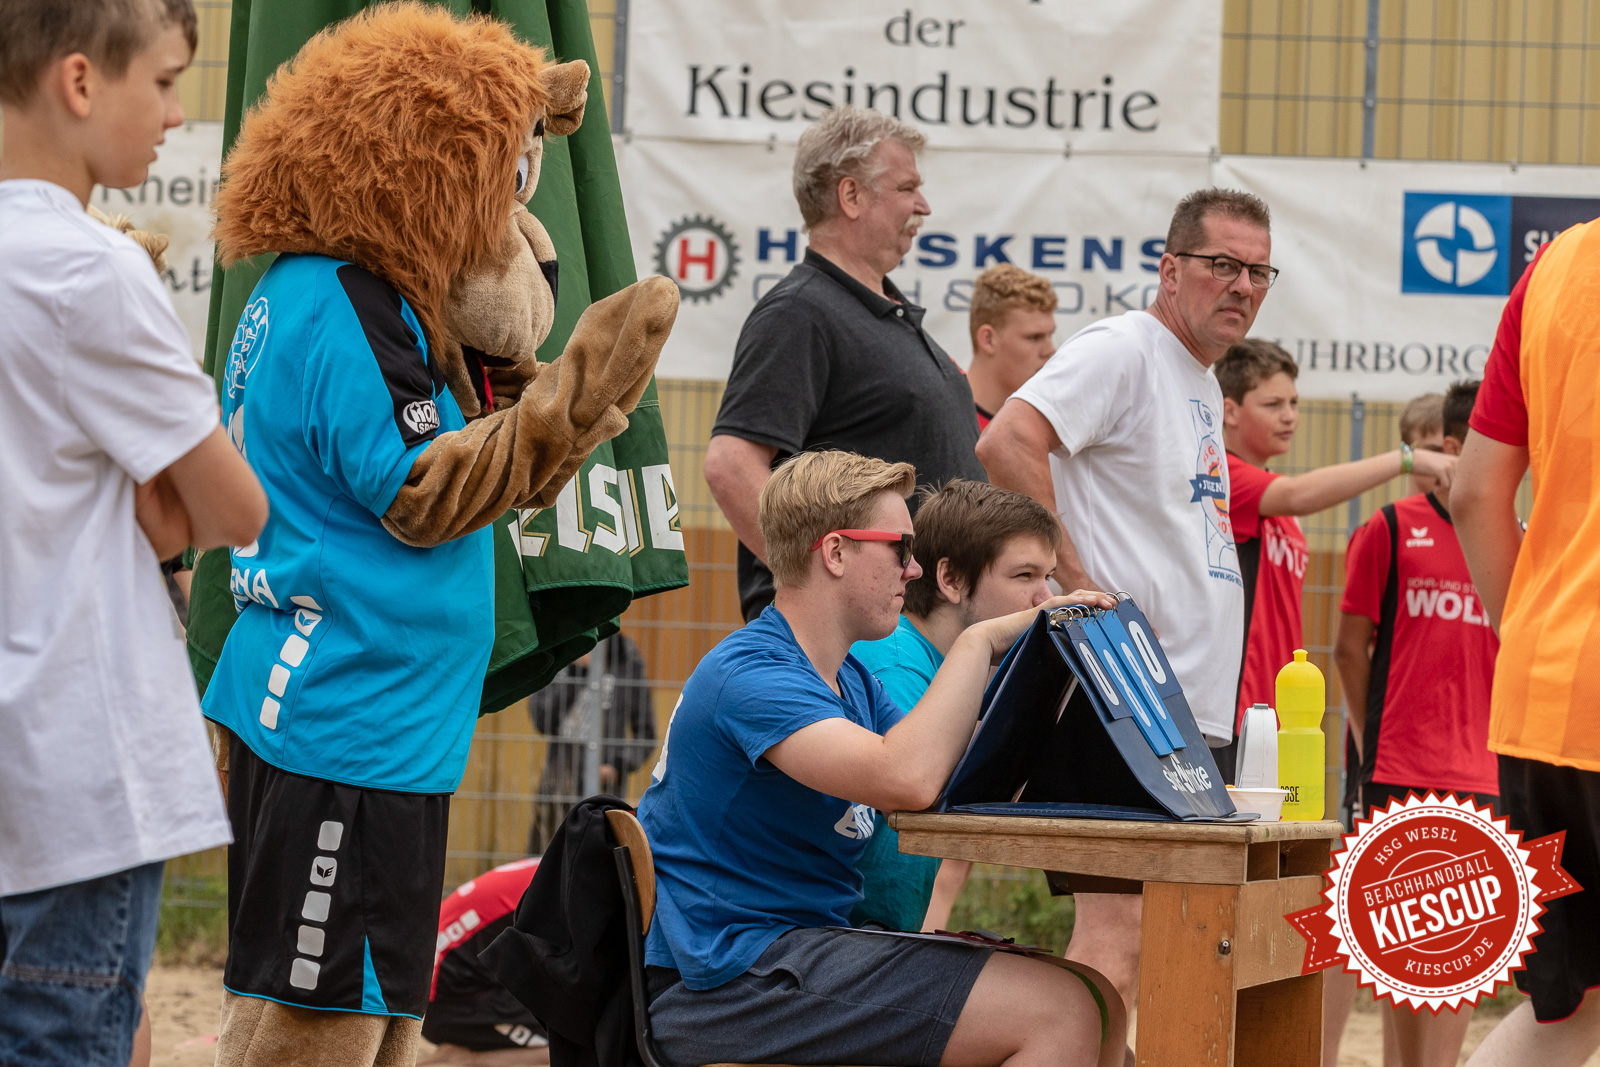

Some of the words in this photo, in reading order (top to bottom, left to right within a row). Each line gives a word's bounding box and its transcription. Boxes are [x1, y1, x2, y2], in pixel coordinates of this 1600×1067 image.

[884, 9, 966, 48] der
[685, 64, 1160, 133] Kiesindustrie
[679, 238, 716, 281] H
[1079, 642, 1120, 706] 0
[1128, 620, 1167, 685] 0
